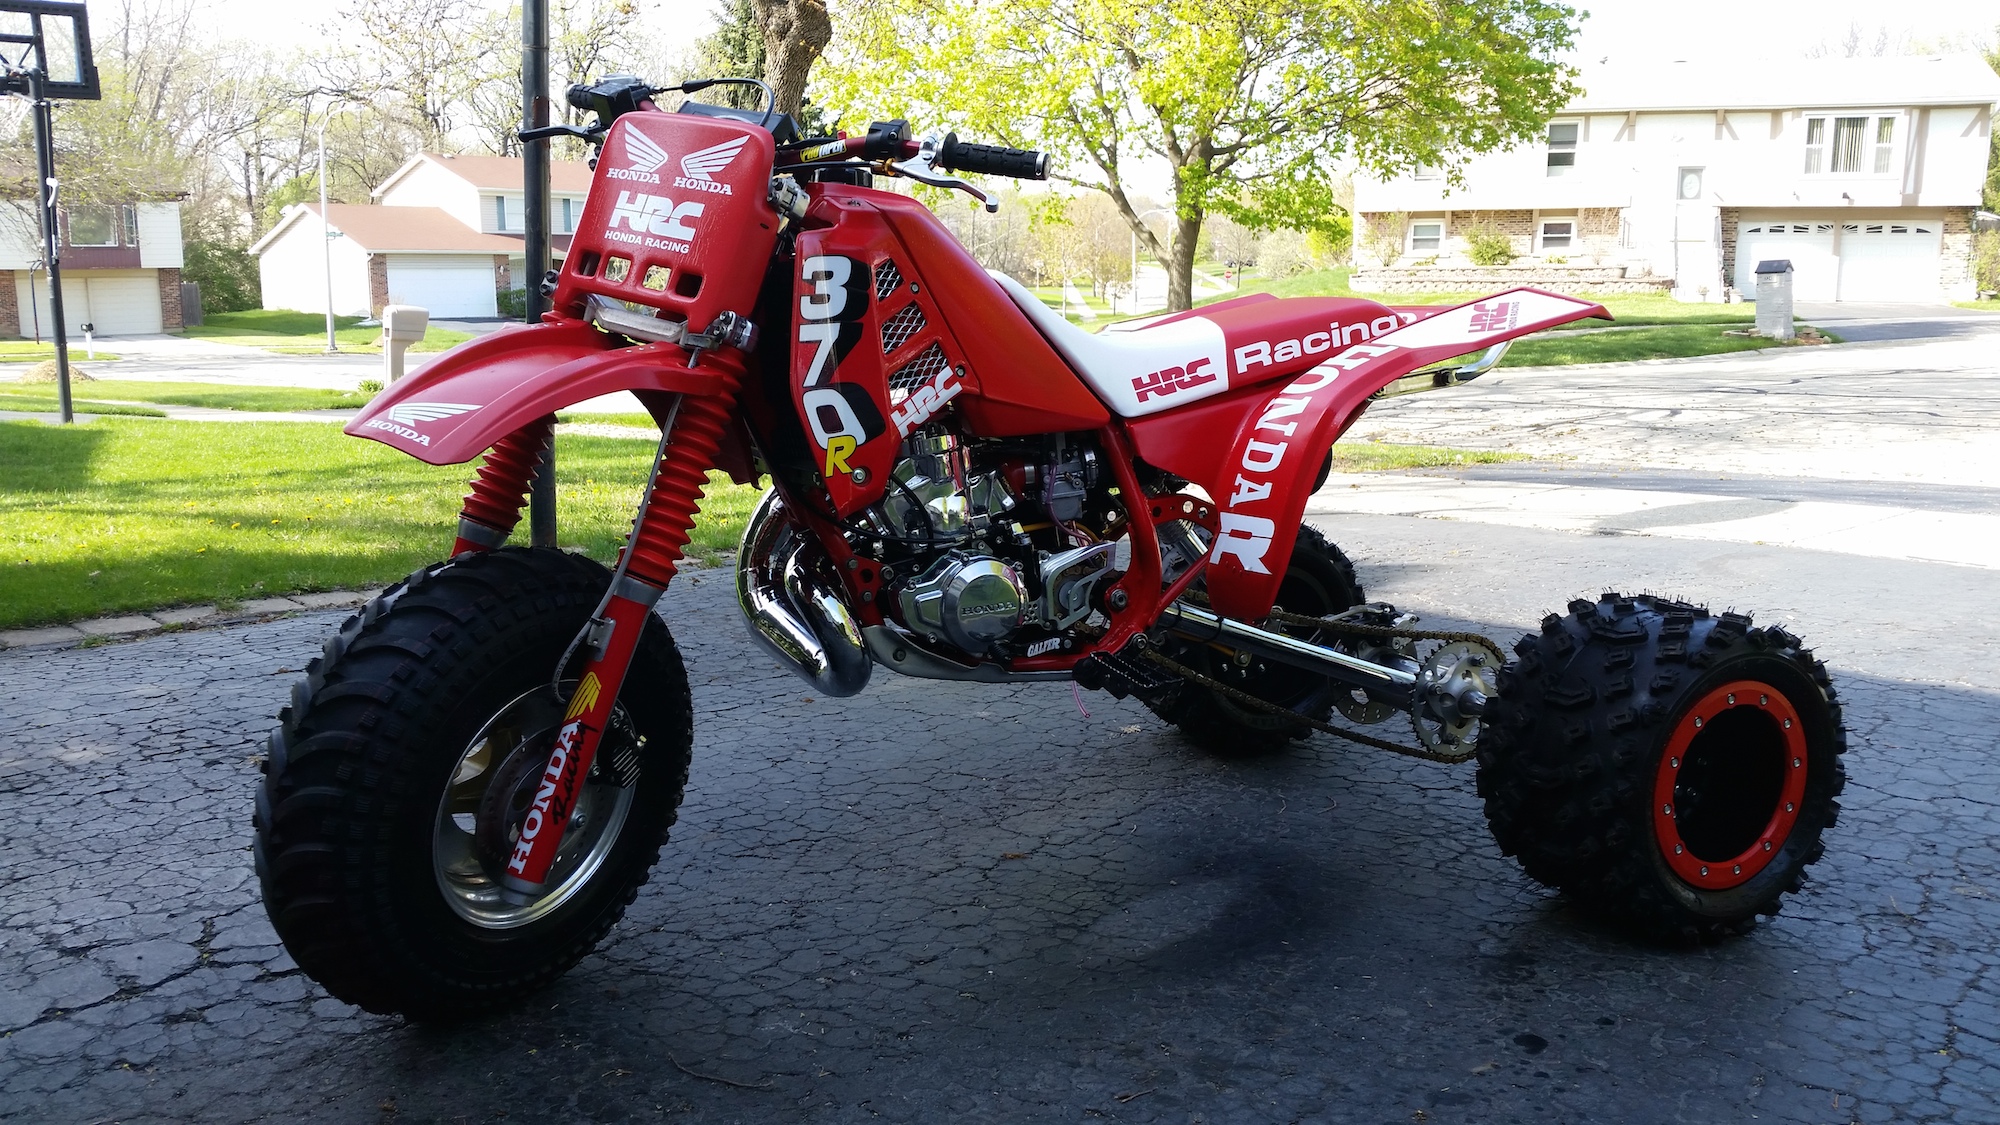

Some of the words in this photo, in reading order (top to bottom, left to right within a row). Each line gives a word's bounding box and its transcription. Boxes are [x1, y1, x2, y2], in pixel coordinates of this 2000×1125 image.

[606, 168, 660, 185] HONDA
[673, 176, 732, 196] HONDA
[608, 190, 706, 242] HRC
[604, 230, 642, 246] HONDA
[645, 237, 690, 254] RACING
[1131, 357, 1217, 403] HRC
[890, 365, 963, 439] HRC
[365, 420, 431, 446] HONDA
[961, 602, 1016, 616] HONDA
[552, 721, 600, 826] Racing
[507, 719, 582, 875] HONDA
